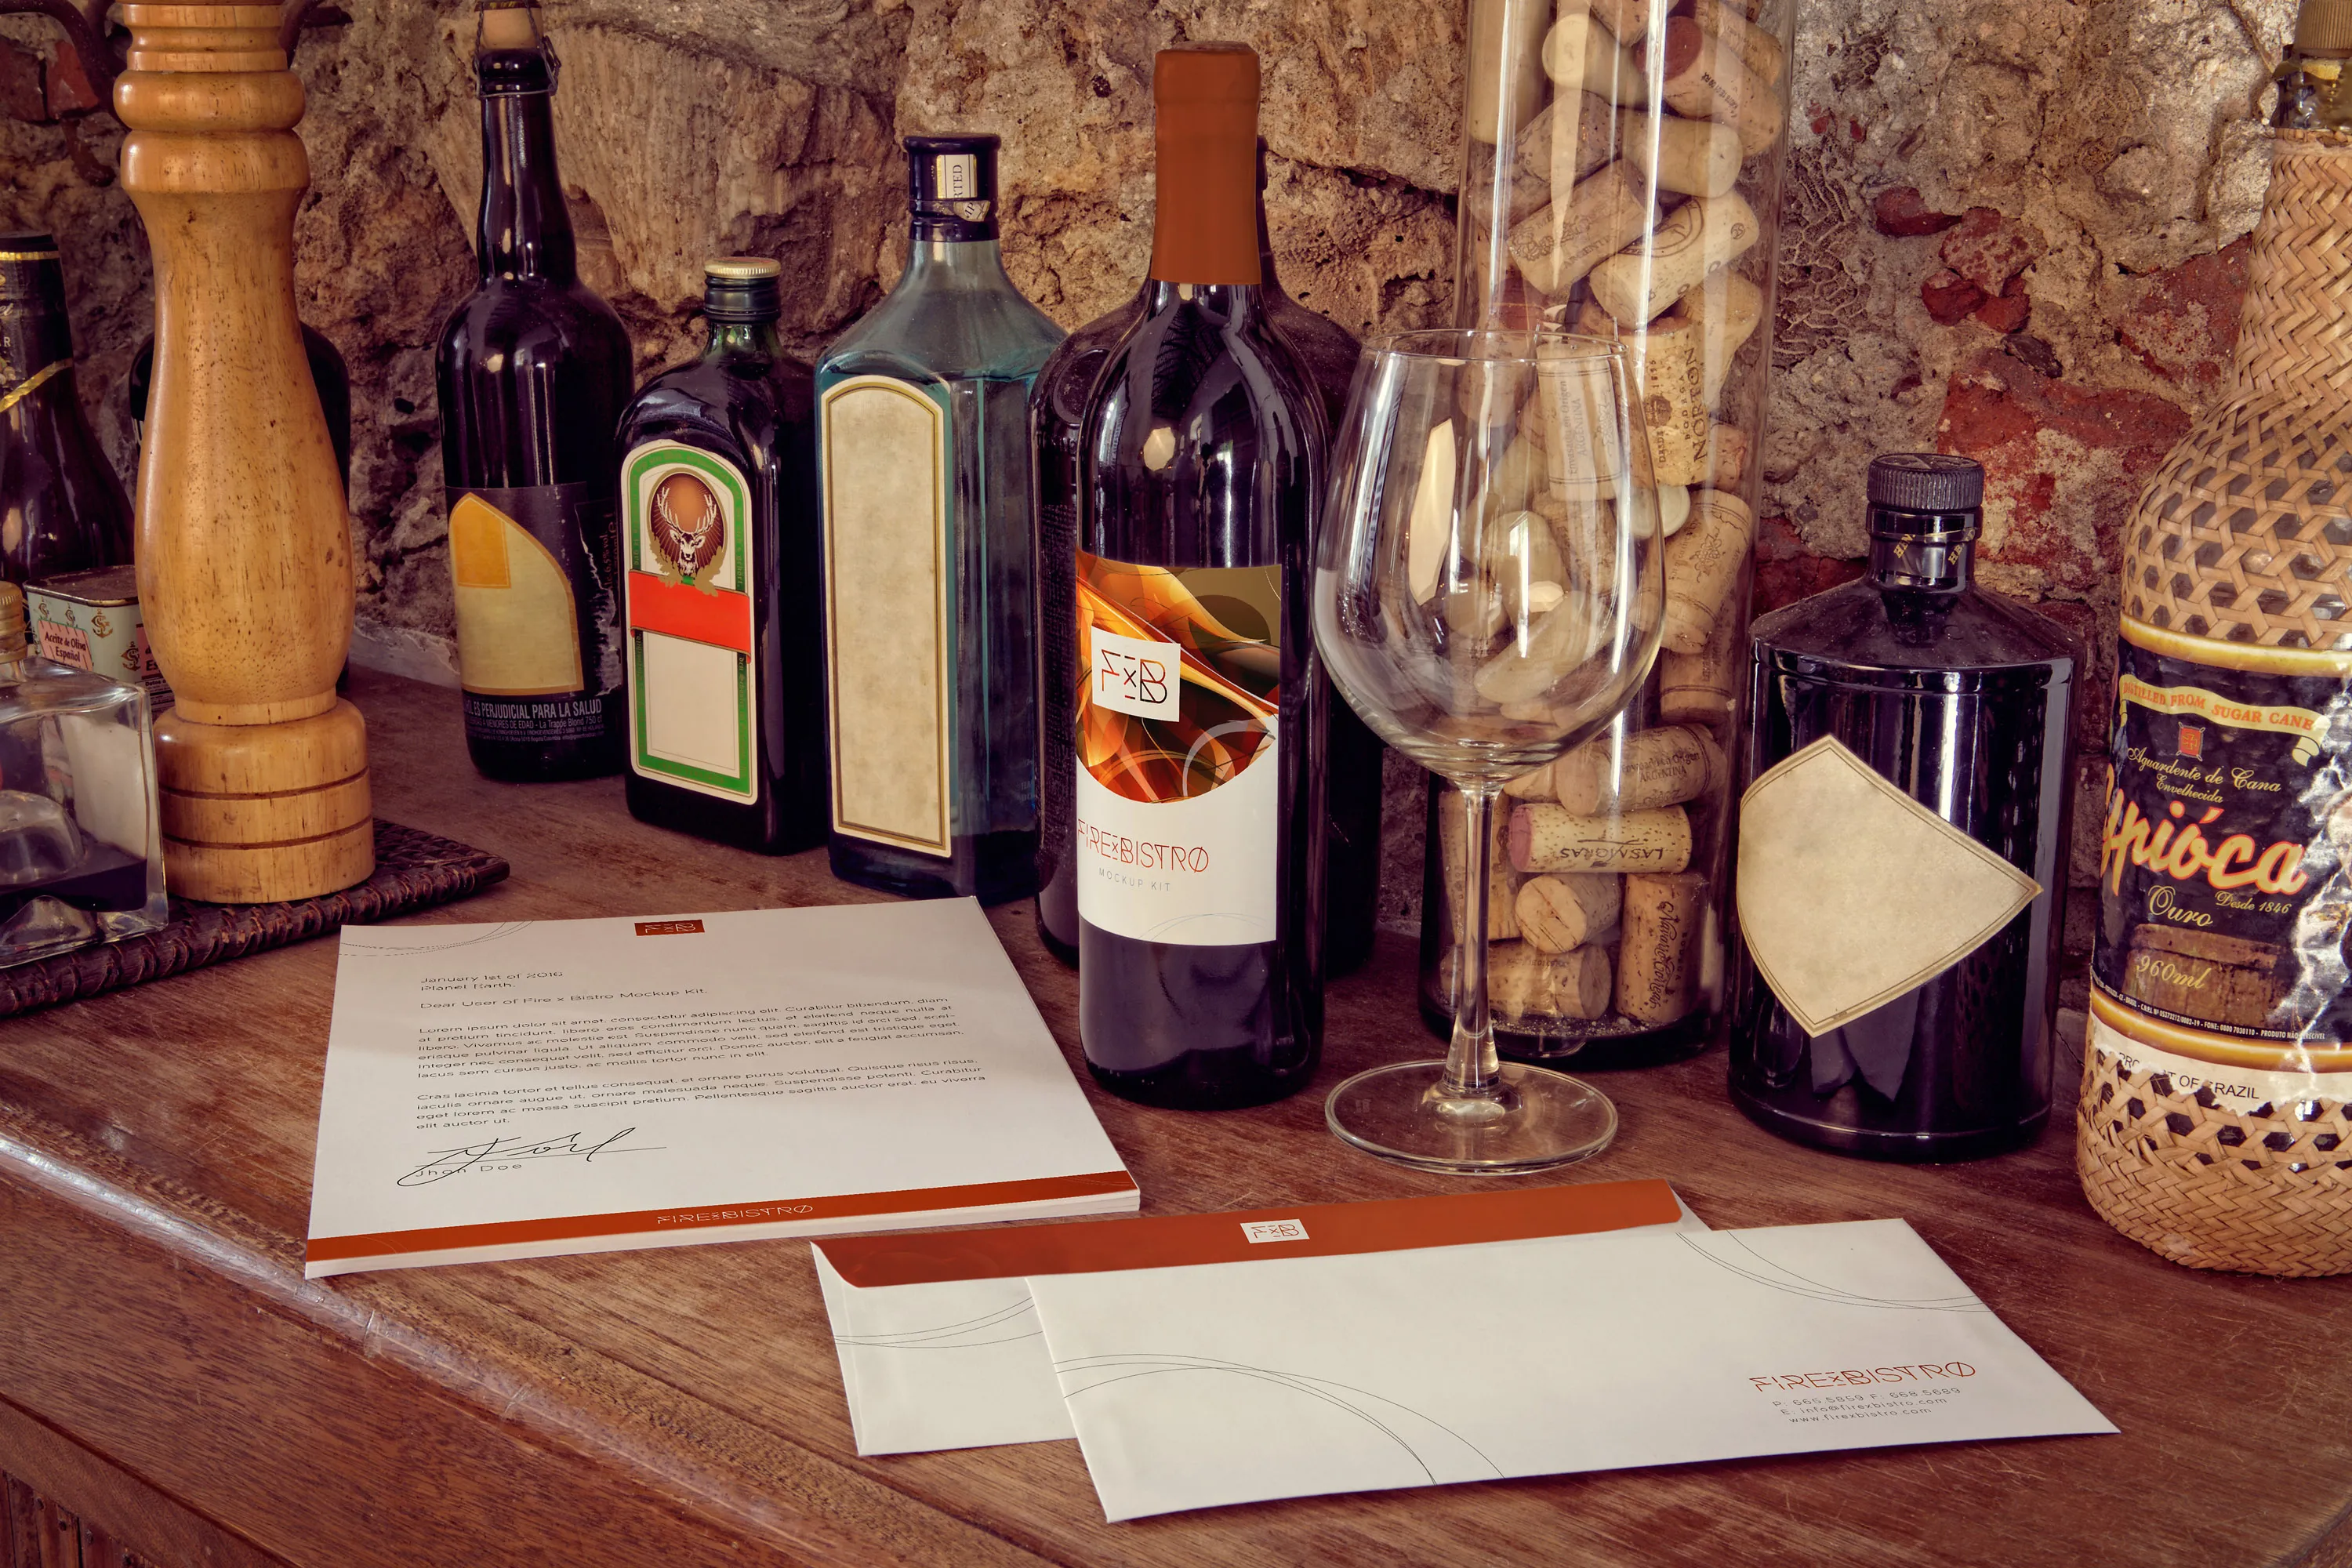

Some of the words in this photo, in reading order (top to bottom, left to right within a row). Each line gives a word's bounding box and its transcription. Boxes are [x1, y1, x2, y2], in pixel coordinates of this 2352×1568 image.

[1685, 347, 1708, 463] NORTON
[44, 632, 64, 645] Aceite
[64, 638, 71, 647] de
[71, 636, 87, 652] Oliva
[55, 646, 81, 663] Español
[481, 702, 531, 719] PERJUDICIAL
[532, 702, 557, 719] PARA
[558, 702, 572, 718] LA
[572, 699, 602, 717] SALUD
[2123, 681, 2166, 706] DISTILLED
[2170, 693, 2205, 710] FROM
[2212, 704, 2263, 724] SUGAR
[2268, 712, 2314, 731] CANE
[568, 717, 584, 727] Blond
[2127, 747, 2201, 782] Aguardente
[2205, 766, 2223, 784] de
[2231, 768, 2281, 792] Cana
[2156, 774, 2223, 804] Envelhecida
[1099, 867, 1144, 887] MOCKUP
[1151, 881, 1171, 892] KIT
[2148, 885, 2212, 927] Ouro
[2215, 891, 2255, 911] Desde
[2259, 902, 2292, 914] 1846
[2220, 1024, 2233, 1033] 0800
[2260, 1030, 2286, 1039] PRODUTO
[2179, 1075, 2200, 1089] OF
[2209, 1081, 2259, 1099] RAZIL
[481, 1163, 522, 1172] Doe
[1788, 1407, 1932, 1424] www.firexbistro.com
[1799, 1397, 1947, 1414] info@firexbistro.com
